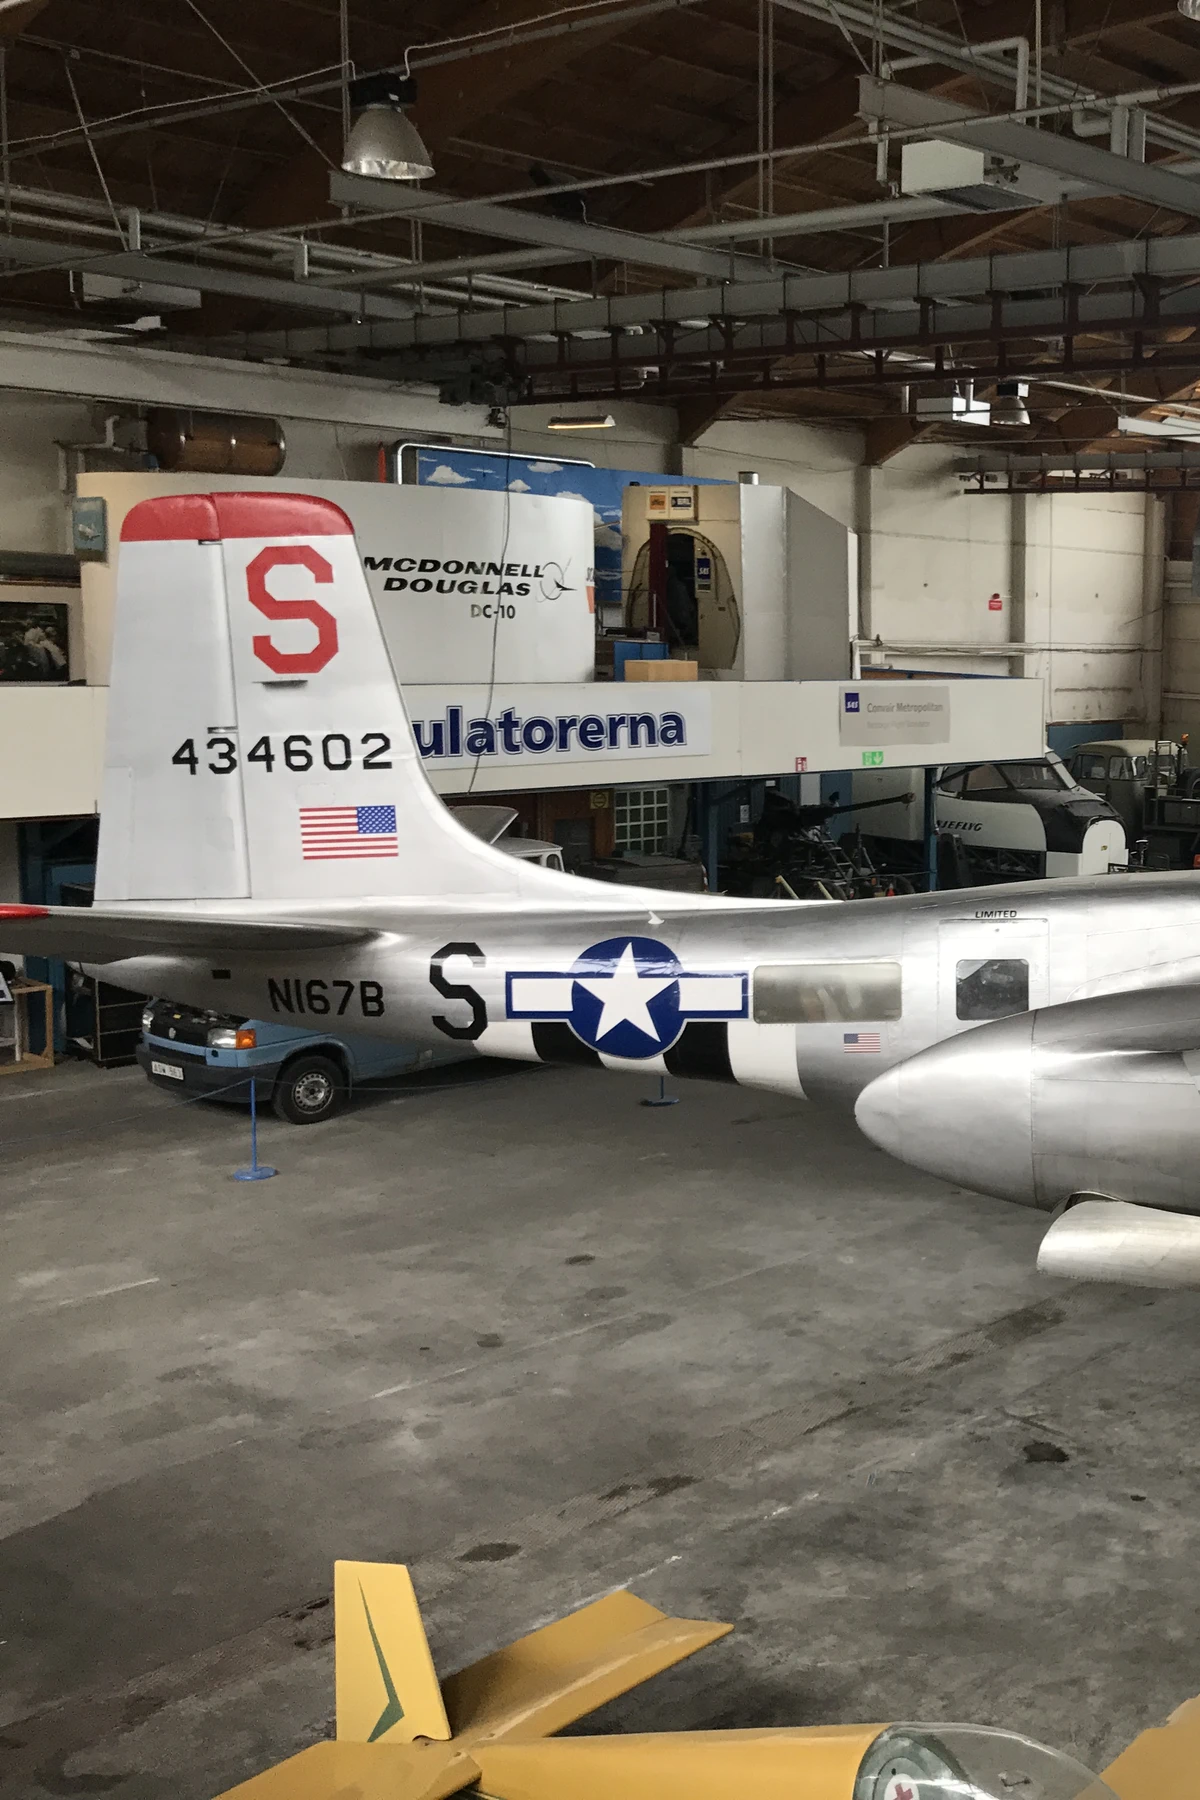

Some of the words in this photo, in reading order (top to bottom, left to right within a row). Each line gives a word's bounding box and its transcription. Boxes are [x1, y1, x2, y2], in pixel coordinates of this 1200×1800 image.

[363, 557, 544, 578] MCDONNELL
[383, 577, 531, 596] DOUGLAS
[246, 545, 339, 674] S
[470, 604, 516, 619] DC-10
[411, 705, 687, 759] ulatorerna
[172, 733, 392, 775] 434602
[975, 910, 1017, 918] LIMITED
[268, 978, 385, 1017] N167B
[429, 942, 488, 1040] S
